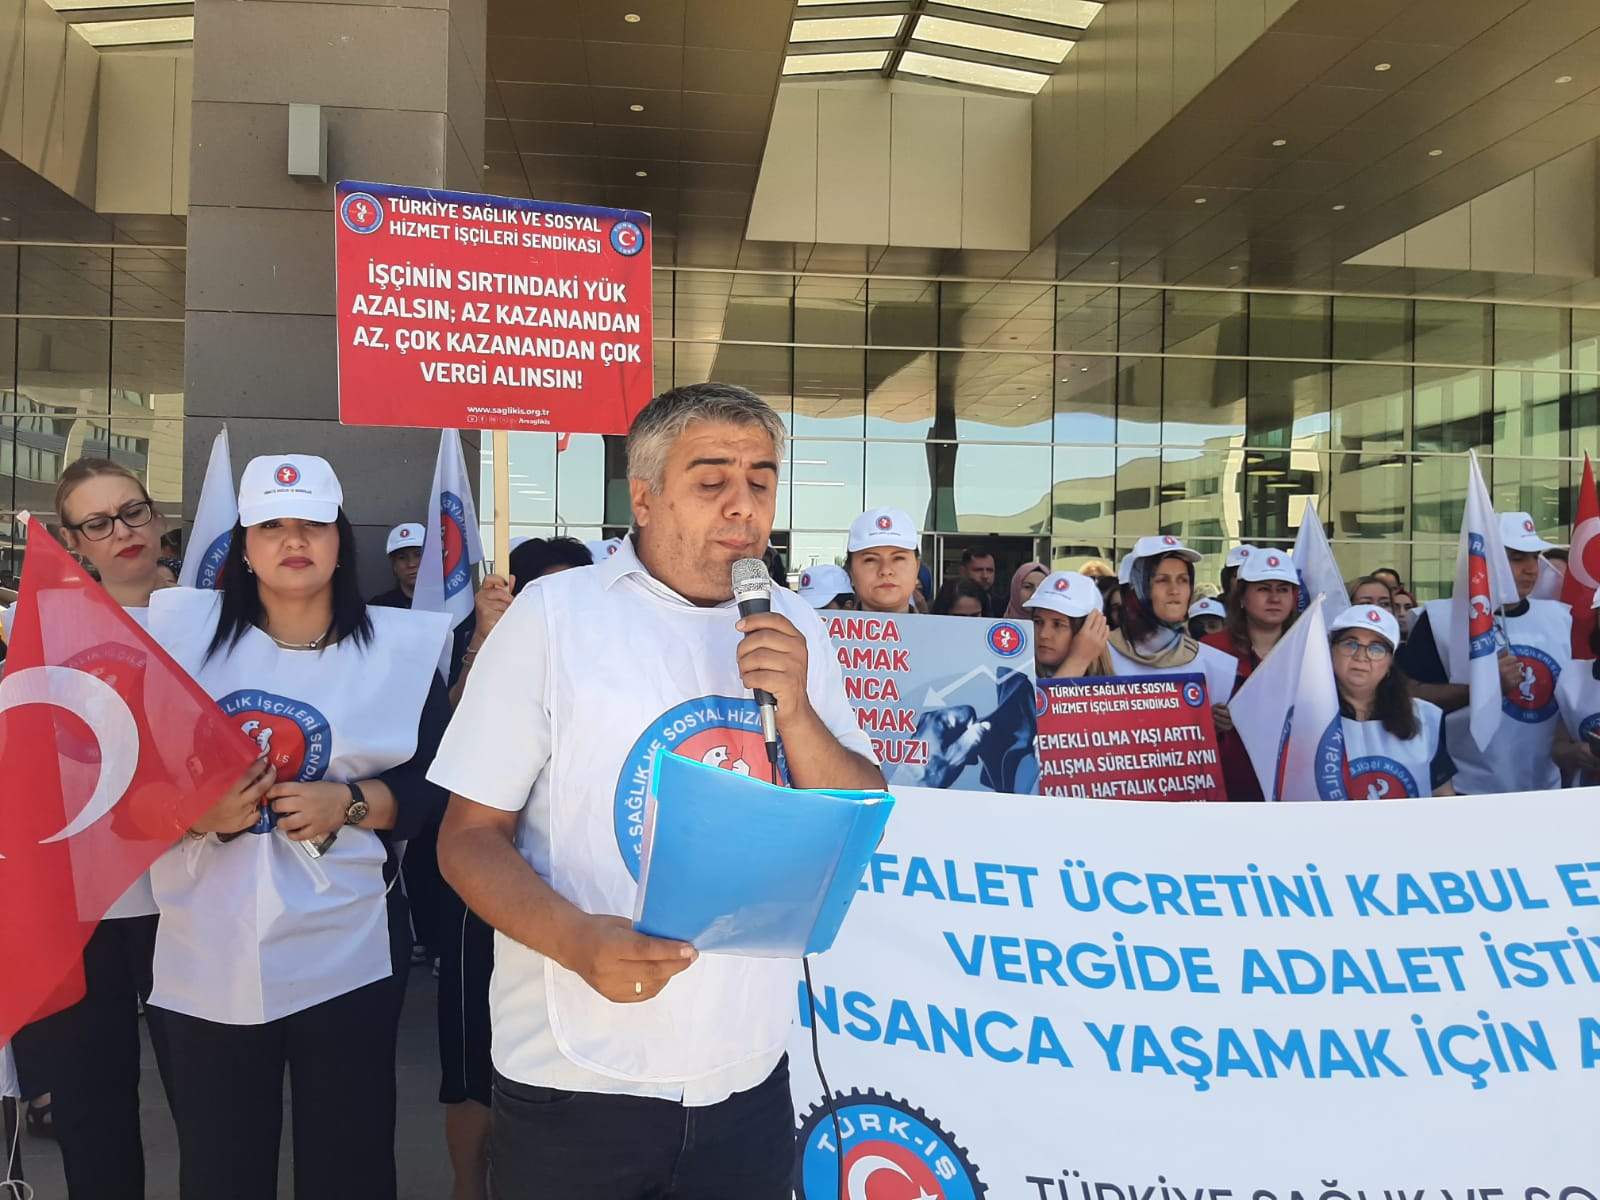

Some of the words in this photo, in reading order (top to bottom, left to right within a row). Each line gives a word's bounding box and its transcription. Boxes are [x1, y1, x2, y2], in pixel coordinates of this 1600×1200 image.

[388, 195, 459, 218] TÜRKİYE
[462, 203, 518, 224] SAĞLIK
[521, 211, 541, 227] VE
[544, 214, 601, 232] SOSYAL
[389, 218, 450, 239] HİZMET
[455, 223, 518, 247] İŞÇİLERİ
[522, 232, 601, 253] SENDİKASI
[368, 258, 451, 291] İŞÇİNİN
[457, 271, 579, 299] SIRTINDAKİ
[583, 277, 627, 303] YÜK
[352, 294, 456, 323] AZALSIN;
[461, 302, 491, 323] AZ
[496, 304, 640, 334] KAZANANDAN
[353, 326, 390, 350] AZ,
[395, 328, 442, 355] ÇOK
[447, 331, 595, 360] KAZANANDAN
[600, 342, 641, 367] ÇOK
[420, 360, 486, 385] VERGİ
[492, 365, 583, 389] ALINSIN!
[466, 406, 550, 416] www.saglikis.org.tr
[829, 616, 900, 642] ANCA
[837, 646, 911, 672] AMAK
[844, 676, 900, 701] NCA
[1049, 684, 1092, 698] TÜRKİYE
[1093, 682, 1126, 696] SAĞLIK
[1129, 683, 1141, 695] VE
[1142, 682, 1178, 695] SOSYAL
[857, 707, 917, 733] MAK
[1052, 700, 1088, 714] HİZMET
[1090, 699, 1130, 716] İŞÇİLERİ
[1131, 697, 1179, 711] SENDİKASI
[226, 696, 252, 713] LIK
[257, 695, 321, 732] İŞÇİLERİ
[300, 732, 322, 782] SENDİ
[871, 738, 930, 765] RUZ!
[1038, 729, 1090, 750] EMEKLİ
[1092, 730, 1130, 747] OLMA
[1131, 728, 1161, 748] YAŞI
[1164, 726, 1205, 743] ARTTI,
[624, 765, 650, 837] SAĞLIK
[663, 708, 725, 742] SOSYAL
[1097, 748, 1185, 772] SÜRELERİMİZ
[1186, 748, 1217, 766] AYNI
[1091, 778, 1156, 799] HAFTALIK
[1158, 773, 1216, 797] ÇALIŞMA
[857, 852, 1039, 908] FALET
[1059, 858, 1334, 917] ÜCRETİNİ
[1344, 867, 1550, 917] KABUL
[942, 930, 1221, 994] VERGİDE
[1241, 945, 1466, 994] ADALET
[797, 980, 1075, 1068] NSANCA
[1083, 1021, 1408, 1092] YAŞAMAK
[1410, 1009, 1558, 1091] İÇİN
[817, 1113, 957, 1180] TÜRK-İŞ
